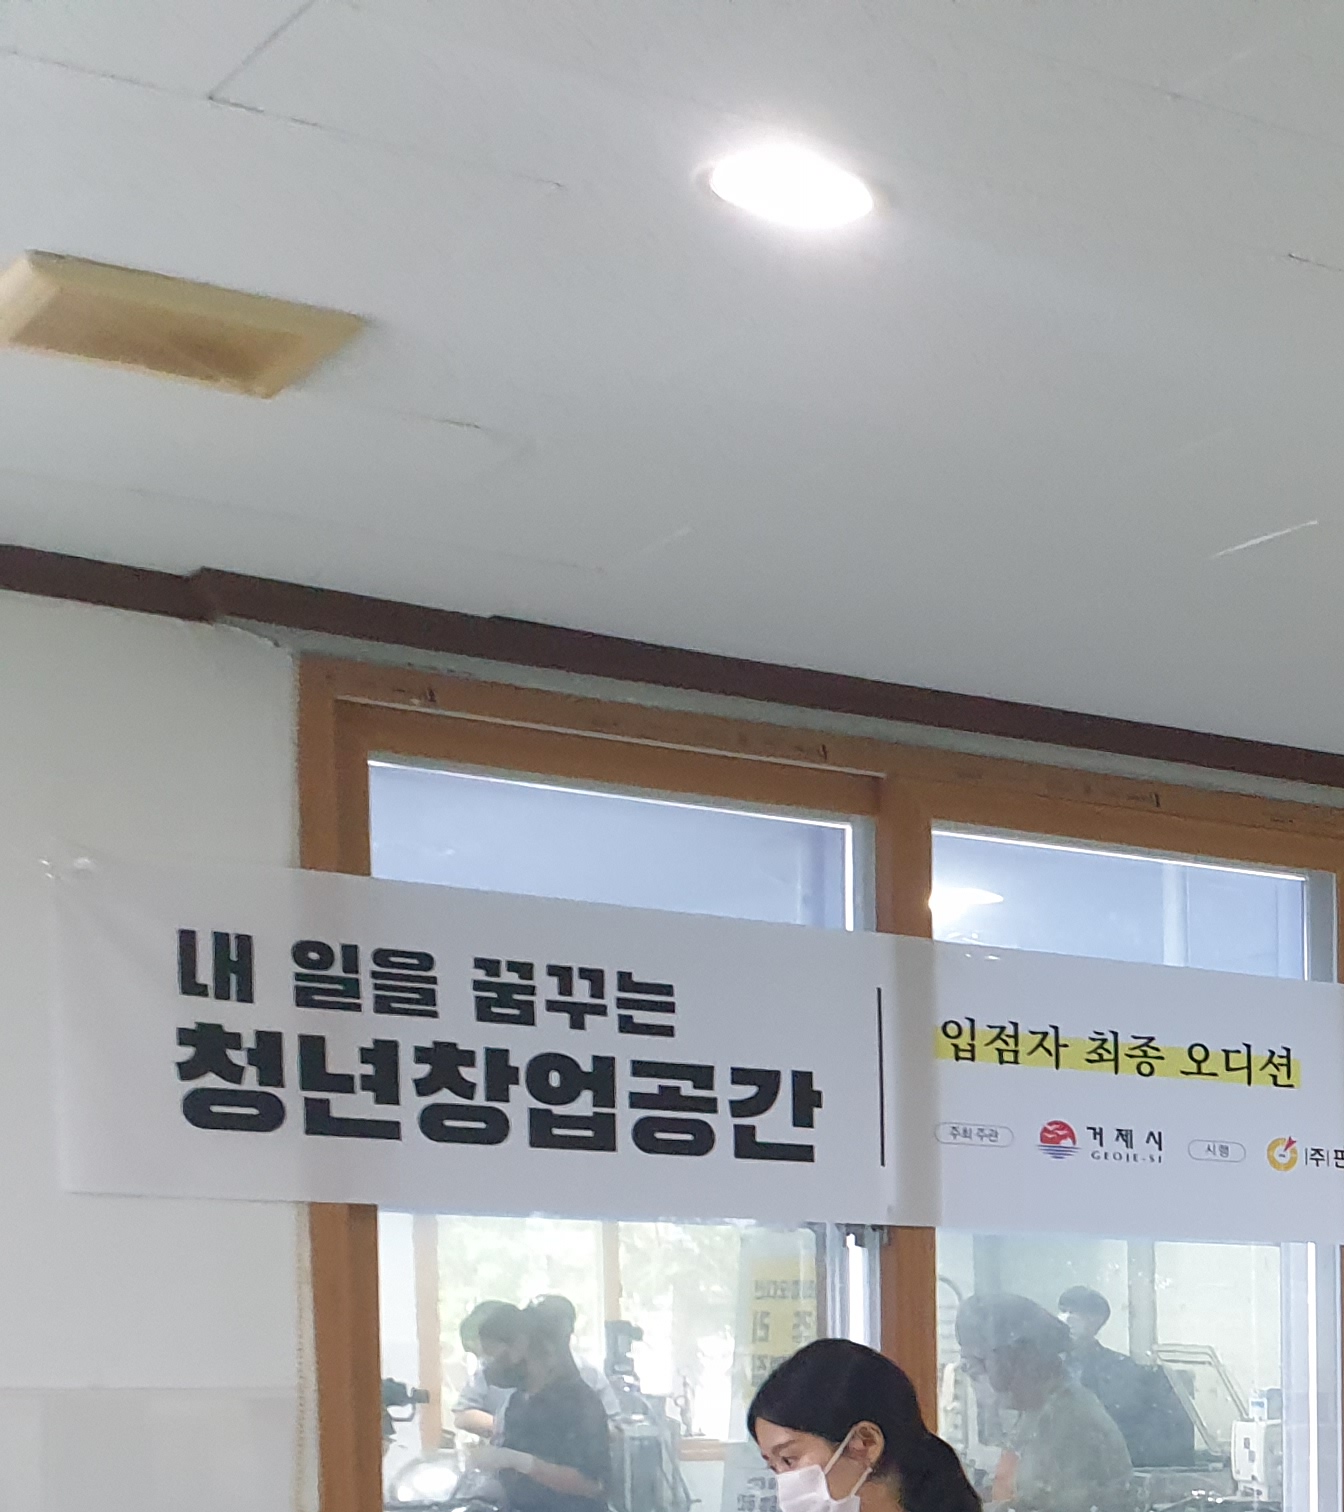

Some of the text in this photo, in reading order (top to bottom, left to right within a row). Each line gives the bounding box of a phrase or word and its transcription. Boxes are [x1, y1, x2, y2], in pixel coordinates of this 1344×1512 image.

[176, 928, 678, 1037] 내 일을 꿈꾸는
[174, 1021, 823, 1163] 청년창업공간
[941, 1016, 1296, 1089] 입점자 최종 오디션
[1086, 1126, 1163, 1151] 거제시
